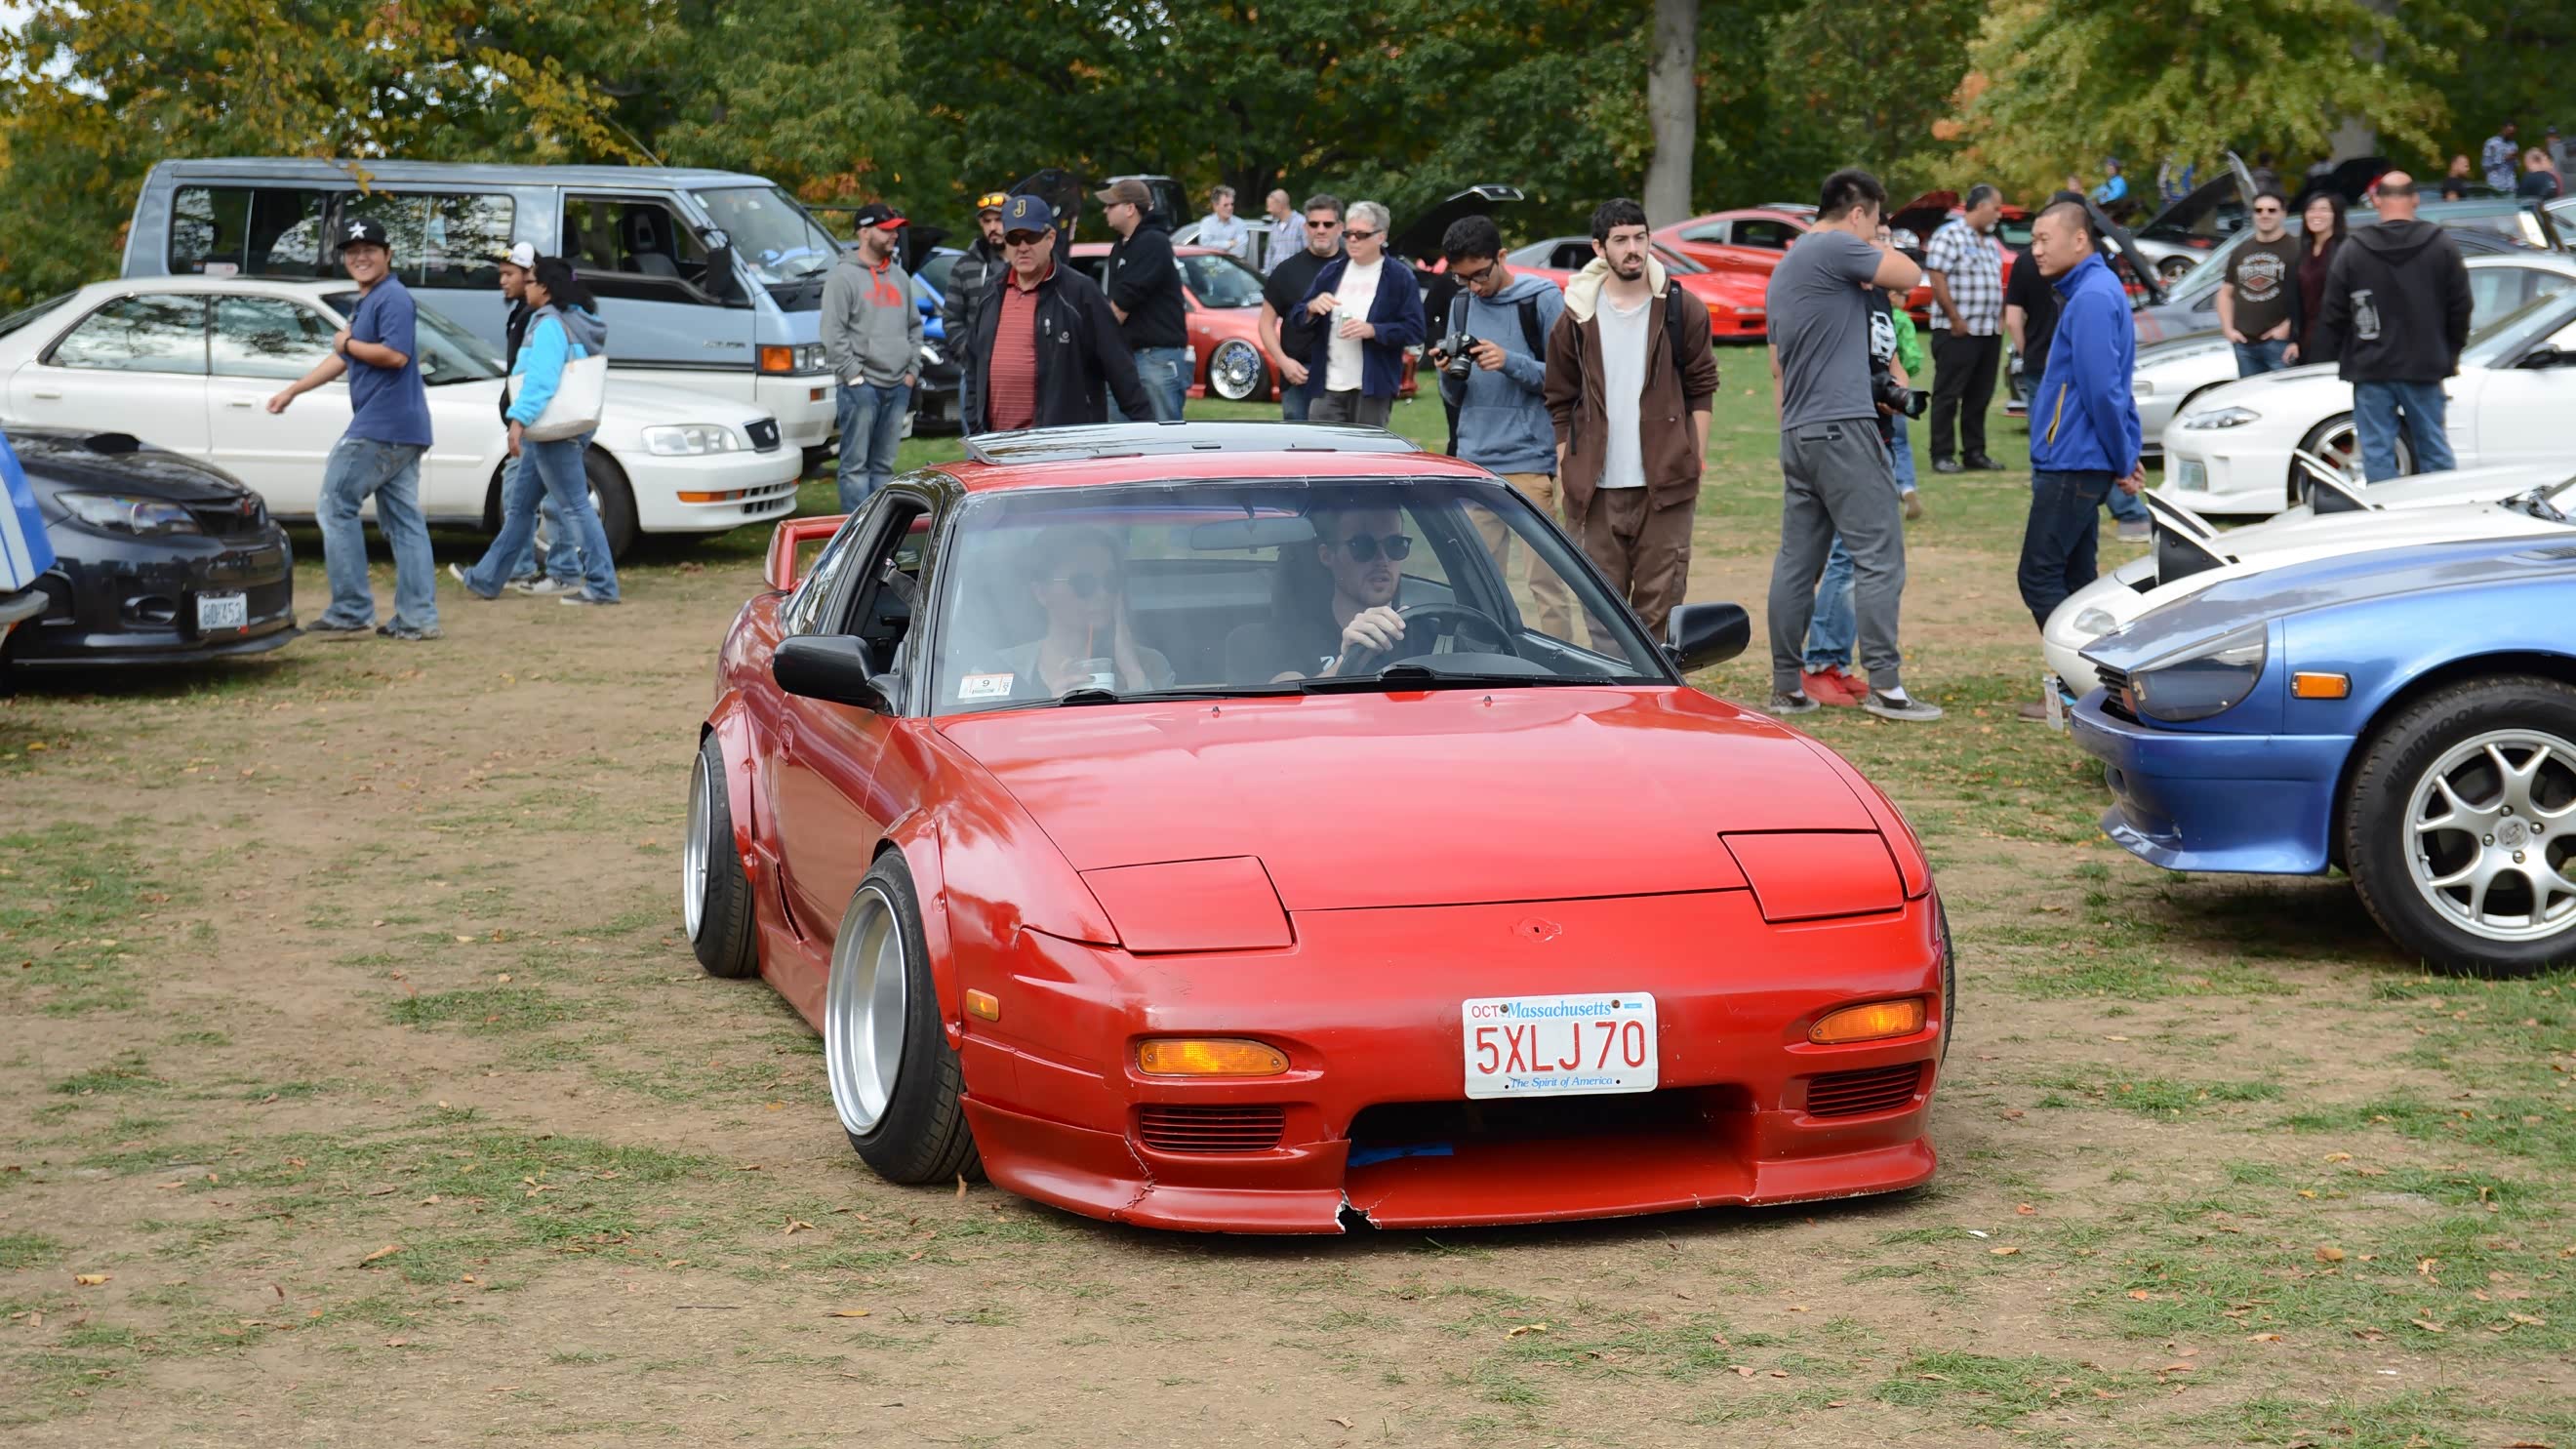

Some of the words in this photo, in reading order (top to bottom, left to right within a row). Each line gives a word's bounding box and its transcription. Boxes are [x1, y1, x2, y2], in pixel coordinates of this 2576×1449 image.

[1013, 199, 1026, 218] J
[1471, 1005, 1499, 1018] OCT
[1508, 1000, 1611, 1018] Massachusetts
[1511, 1078, 1529, 1088] The
[1531, 1076, 1558, 1089] Spirit
[1560, 1076, 1570, 1088] of
[1572, 1076, 1613, 1086] America
